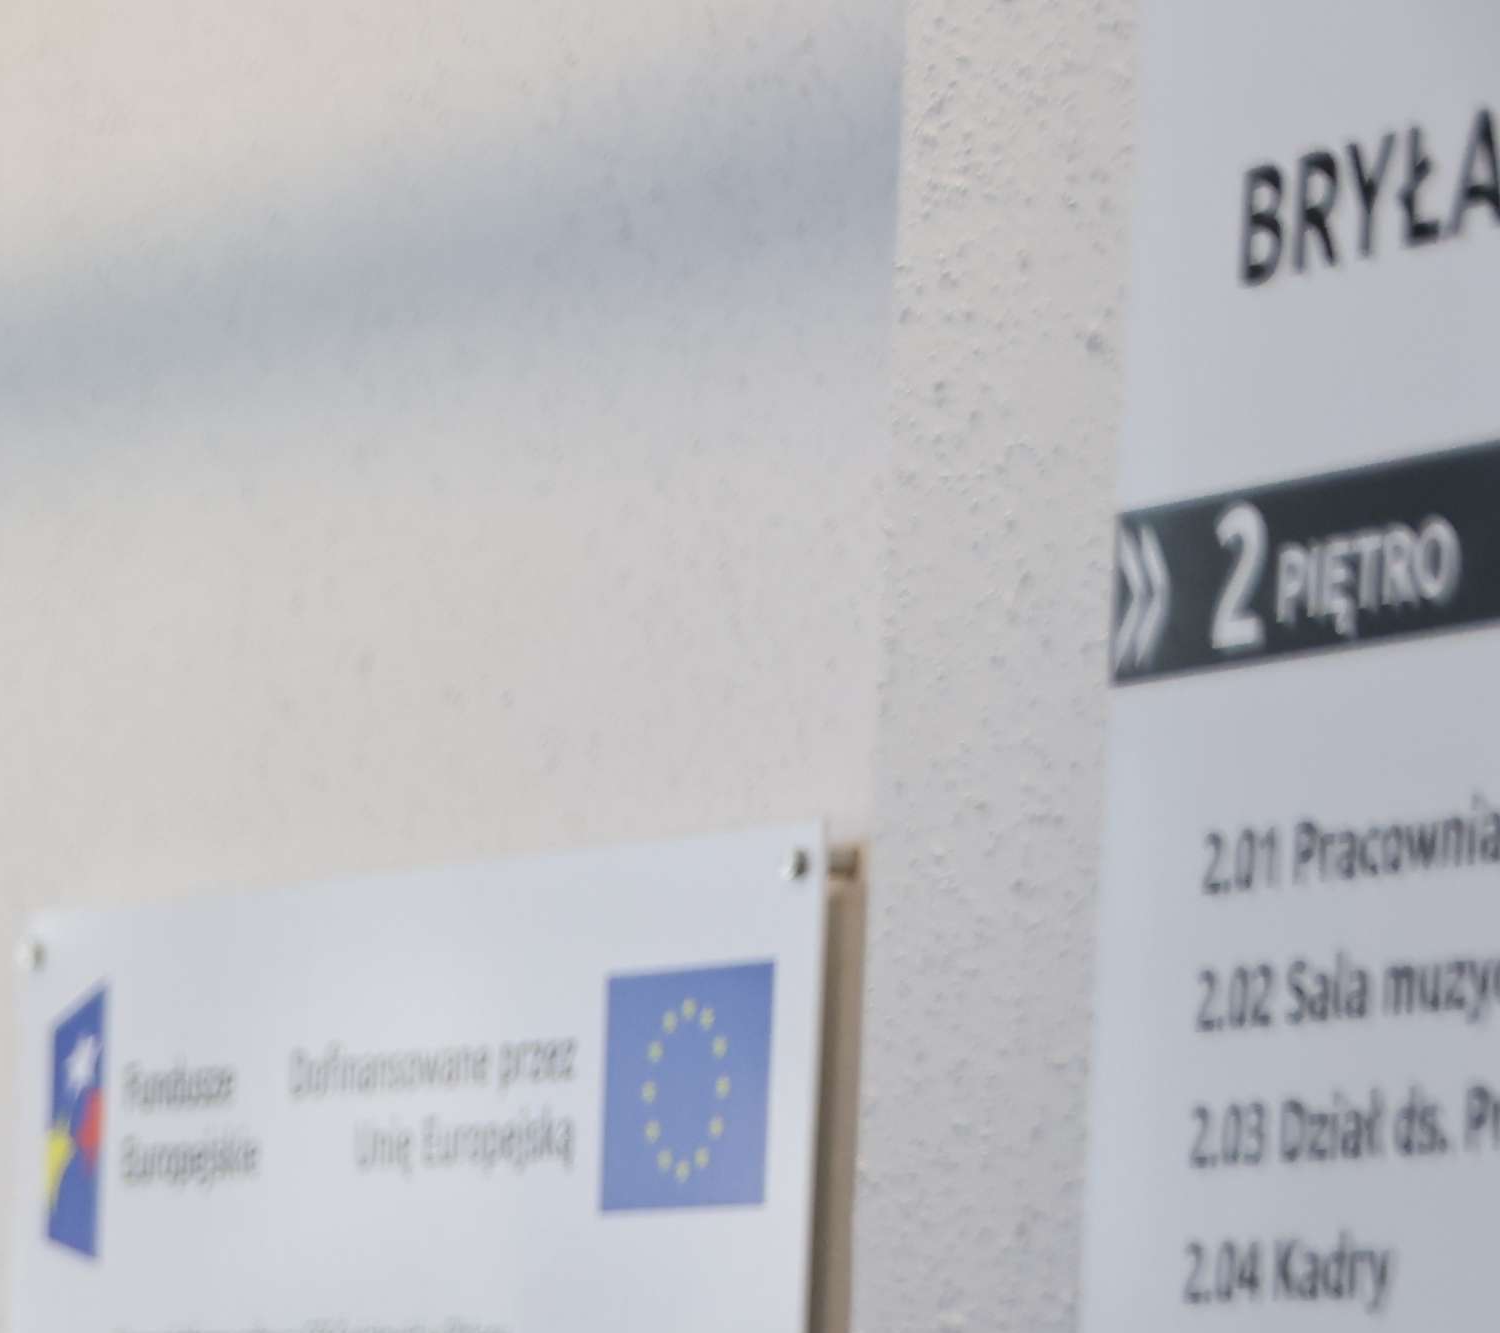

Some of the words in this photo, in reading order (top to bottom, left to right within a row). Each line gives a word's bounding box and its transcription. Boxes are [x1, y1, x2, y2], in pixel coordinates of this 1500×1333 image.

[1240, 106, 1500, 288] BRYŁA
[1210, 500, 1268, 652] 2
[1274, 514, 1462, 640] PIĘTRO
[1200, 825, 1280, 897] 2.01
[1292, 793, 1500, 884] Pracownia
[1194, 960, 1275, 1033] 2.02
[1284, 950, 1370, 1027] Sala
[1188, 1099, 1267, 1170] 2.03
[1277, 1086, 1384, 1164] Dział
[1390, 1082, 1449, 1157] ds.
[1182, 1238, 1262, 1305] 2.04
[1271, 1226, 1393, 1316] Kadry
